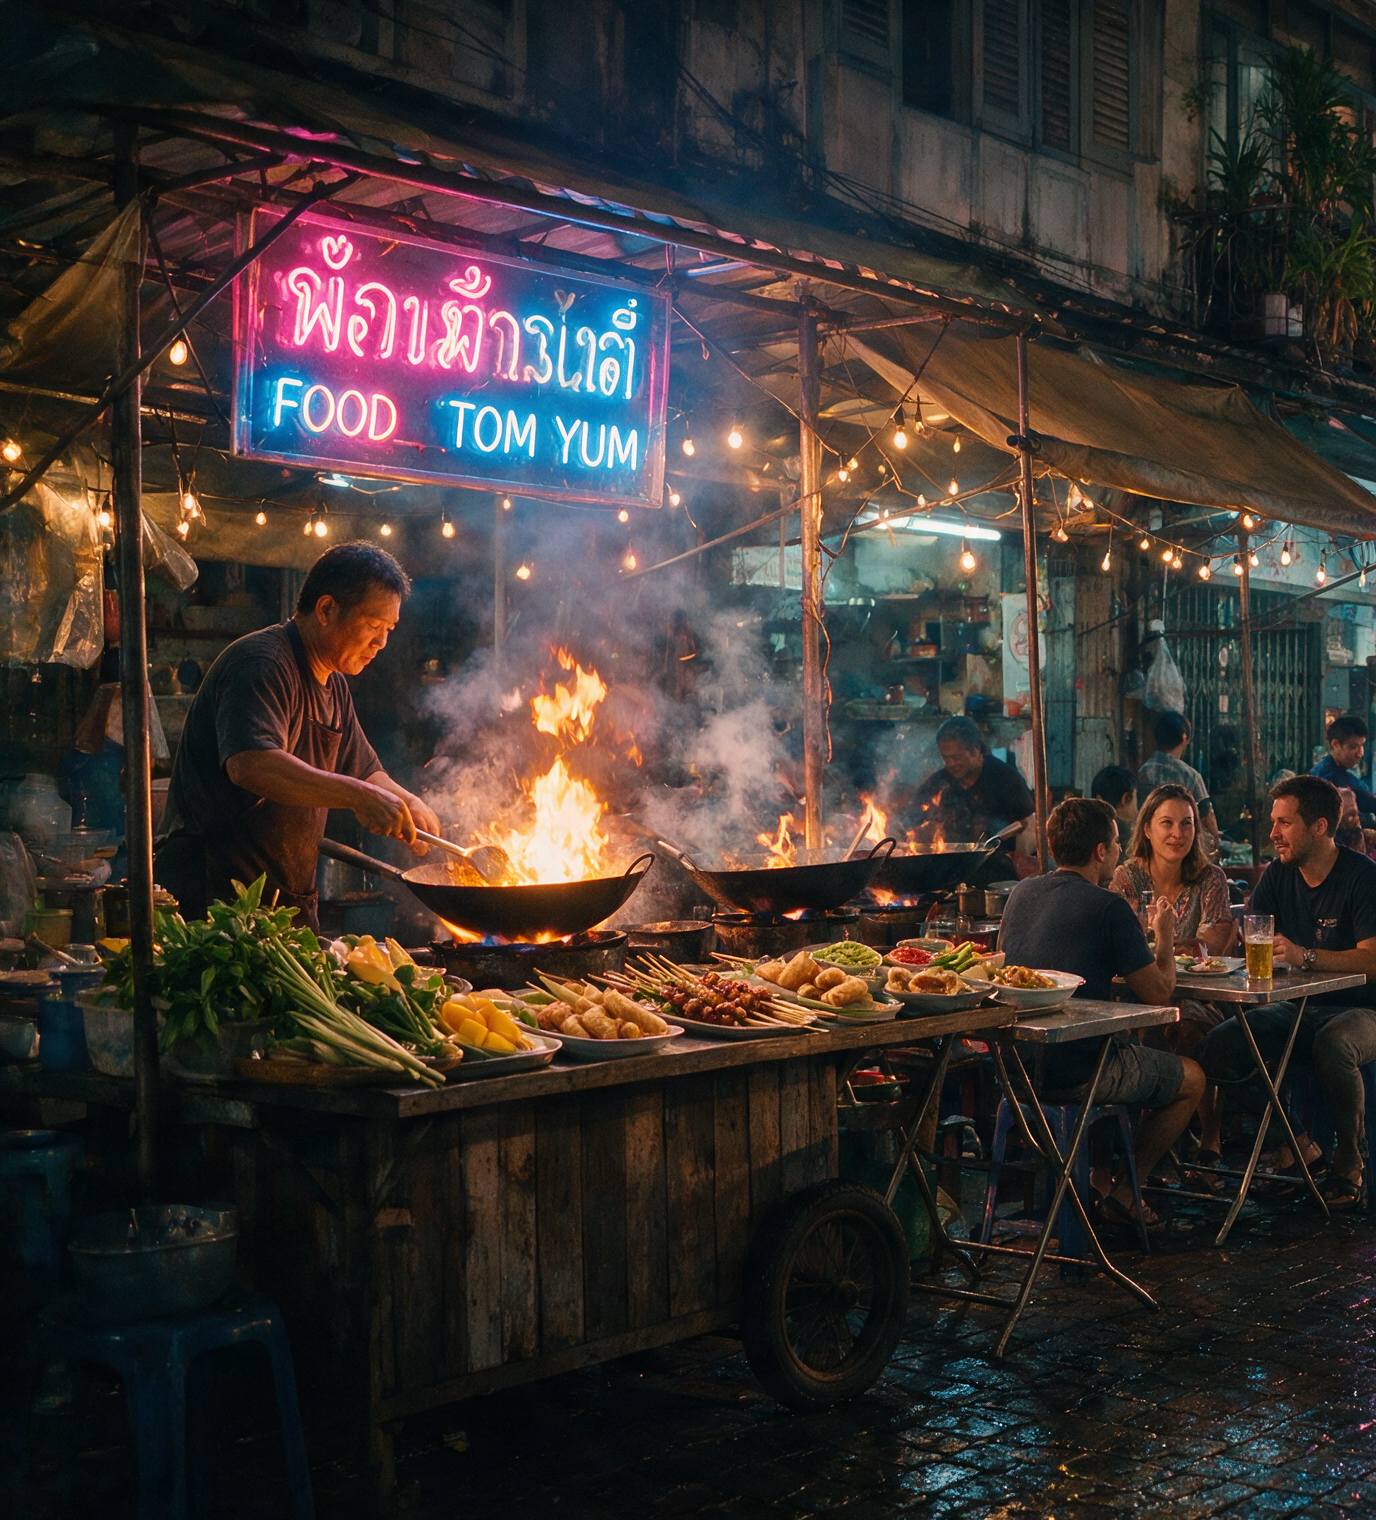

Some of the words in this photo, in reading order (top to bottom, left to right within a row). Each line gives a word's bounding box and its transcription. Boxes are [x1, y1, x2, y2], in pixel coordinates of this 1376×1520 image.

[273, 377, 398, 441] FOOD
[448, 400, 537, 457] TOM
[555, 416, 637, 470] YUM
